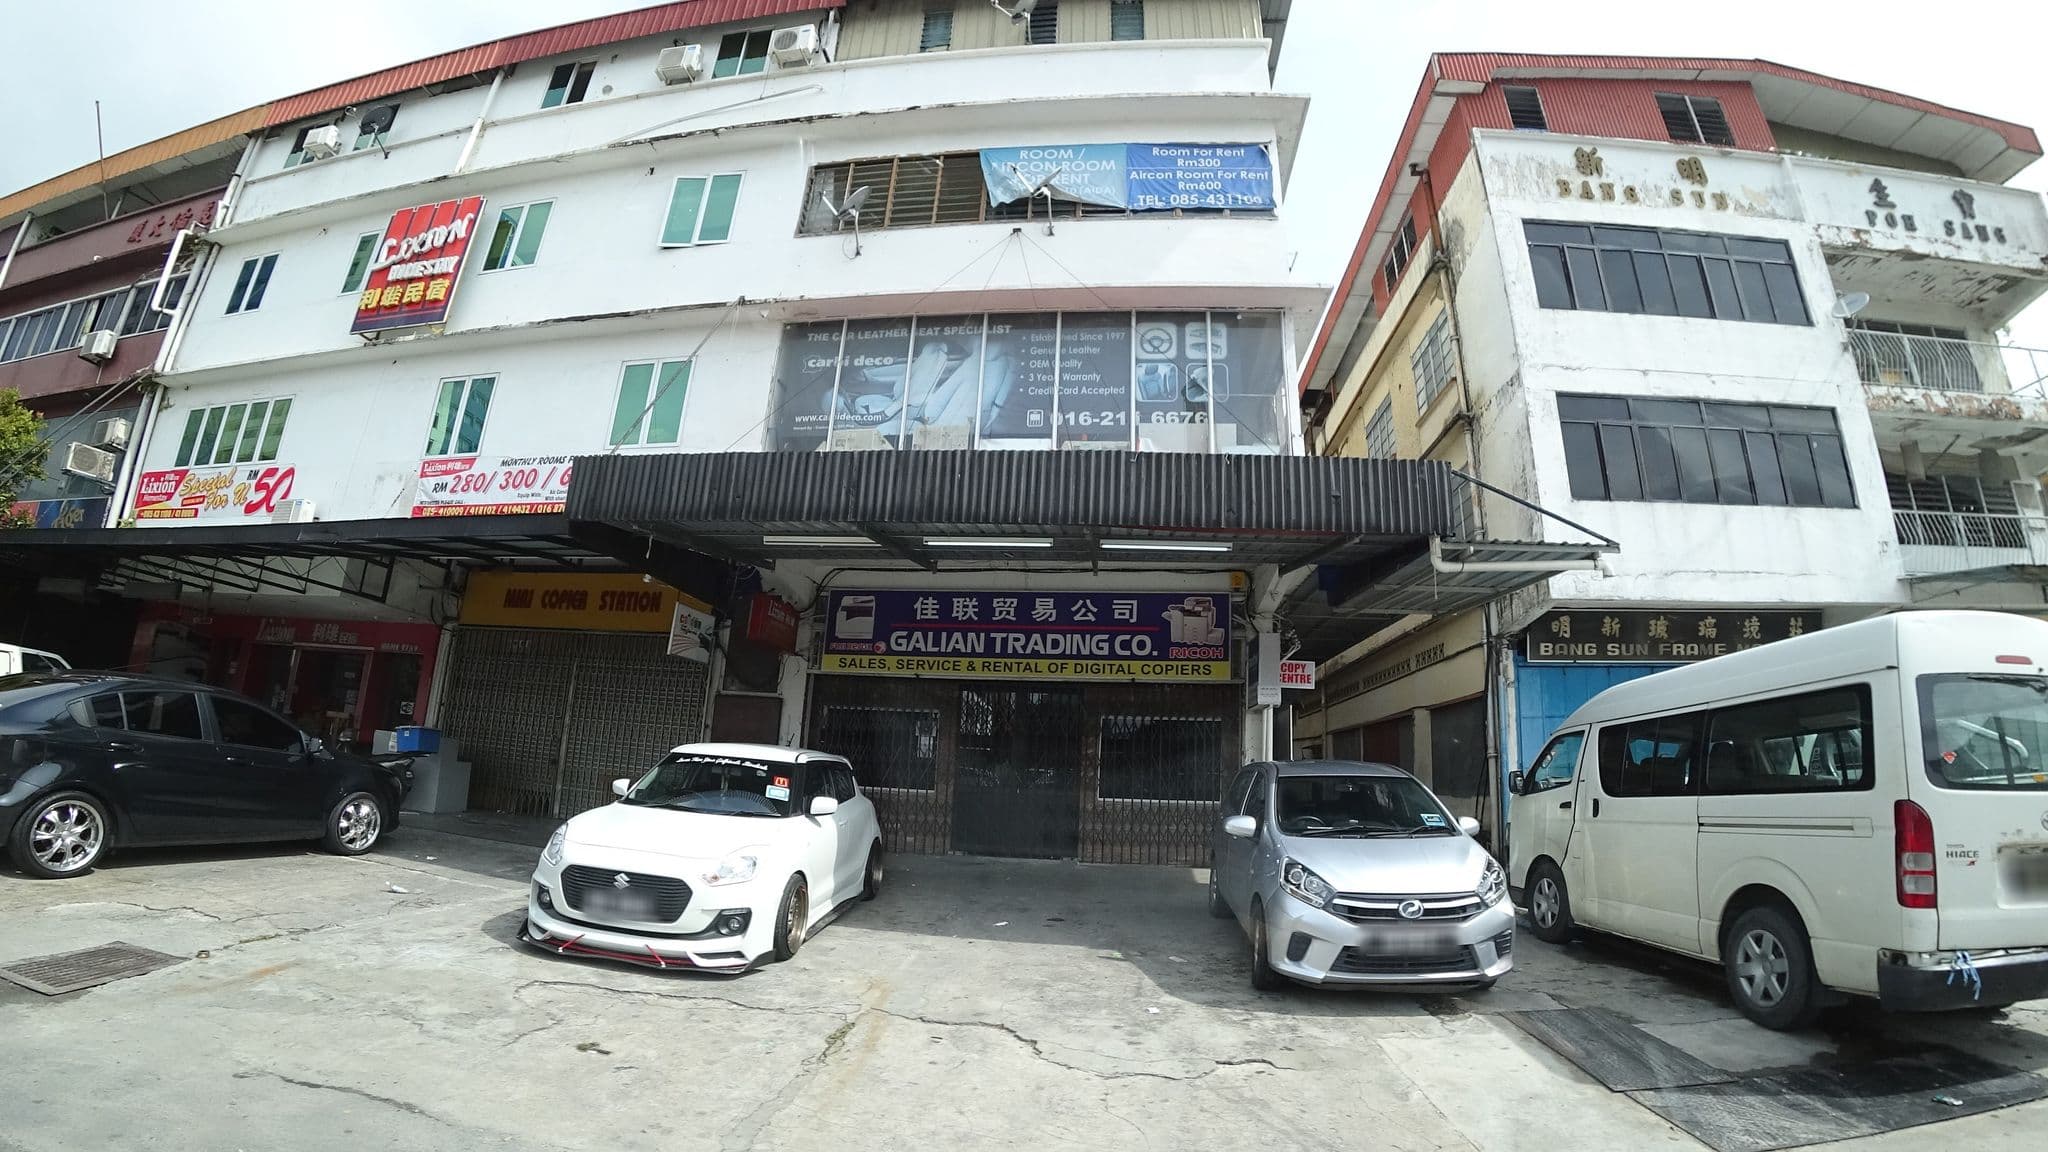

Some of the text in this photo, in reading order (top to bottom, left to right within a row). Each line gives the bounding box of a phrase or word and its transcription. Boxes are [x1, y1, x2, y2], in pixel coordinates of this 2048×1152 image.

[1020, 149, 1073, 159] ROOM
[1152, 147, 1245, 157] Room For Rent
[1061, 160, 1116, 171] ROOM
[1178, 158, 1220, 167] Rm300
[1130, 170, 1268, 180] Aircon Room For Rent
[1178, 182, 1221, 191] Rm600
[1138, 195, 1166, 206] TEL:
[1669, 188, 1729, 211] SUN
[808, 333, 829, 341] THE
[858, 329, 908, 339] LEATHER
[911, 327, 941, 337] EAT
[1106, 332, 1125, 341] 1997
[1030, 347, 1100, 355] Genue Leather
[854, 355, 893, 366] deco
[1030, 360, 1049, 368] OEM
[1028, 373, 1101, 383] 3 Yea Warranty
[1056, 386, 1078, 395] Card
[1080, 386, 1125, 396] Accepted
[795, 413, 882, 423] www.caideco.com
[500, 457, 536, 467] MONTHLY
[538, 456, 566, 465] ROOMS
[247, 469, 260, 480] RM
[140, 477, 176, 494] Lixion
[432, 482, 448, 494] RM
[499, 468, 538, 491] 300
[599, 590, 663, 613] STATION
[914, 597, 1138, 623] 佳联贸易公司
[890, 631, 1158, 656] GALIAN TRADING CO.
[1169, 647, 1224, 659] RICOH
[1540, 643, 1597, 656] BANG
[1606, 643, 1649, 656] SUN
[1659, 643, 1727, 656] FRAME
[838, 657, 1212, 676] SALES, SERVICE & RENTAL OF DIGITAL COPIERS
[1281, 663, 1306, 673] COPY
[1280, 674, 1311, 684] ENTRE
[1946, 850, 1979, 858] HIACE
